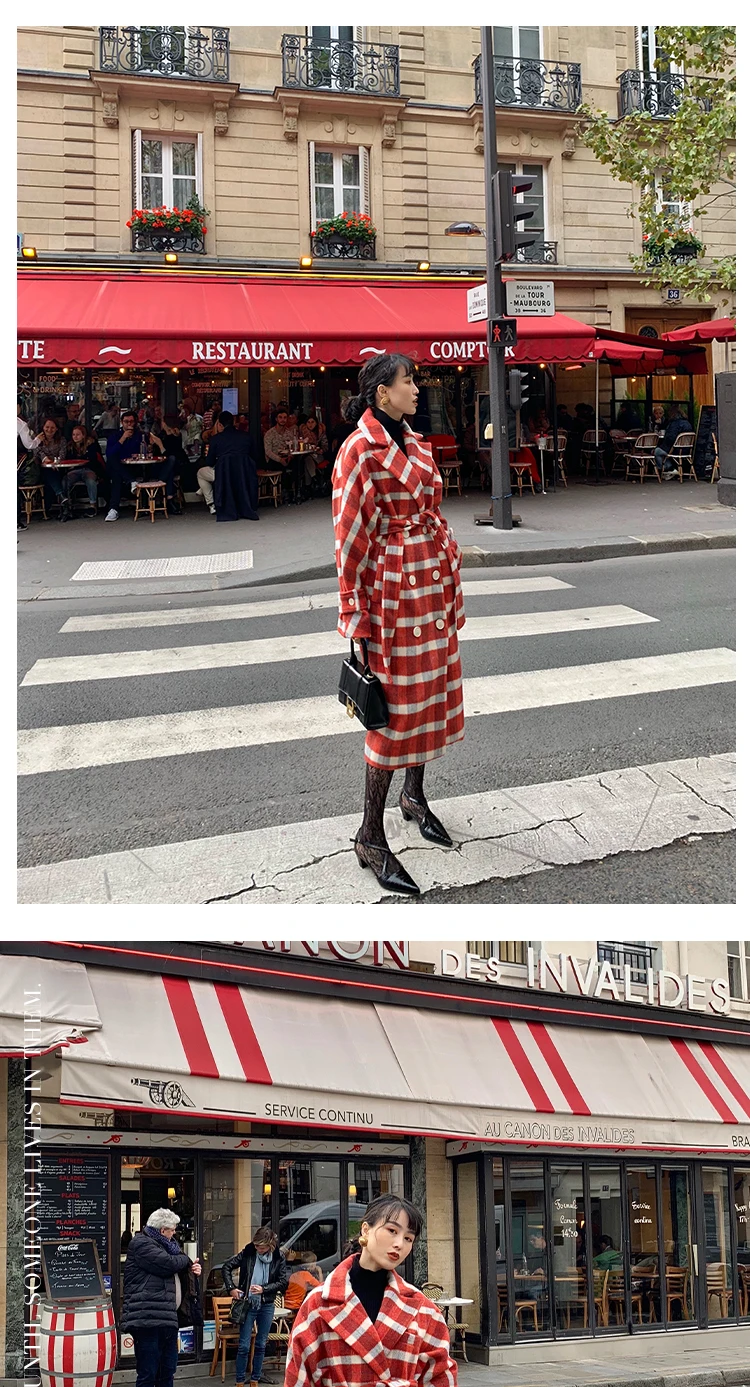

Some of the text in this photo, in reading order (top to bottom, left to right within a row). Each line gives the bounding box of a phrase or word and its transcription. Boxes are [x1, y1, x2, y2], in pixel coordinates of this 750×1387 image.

[669, 290, 679, 298] 36
[192, 341, 314, 360] RESTAURANT
[430, 341, 515, 358] COMPTR
[440, 949, 502, 982] DES
[527, 947, 731, 1016] INVALIDES
[264, 1103, 374, 1125] SERVICE CONTINU
[484, 1121, 635, 1144] AU CANON DES INVALIDES
